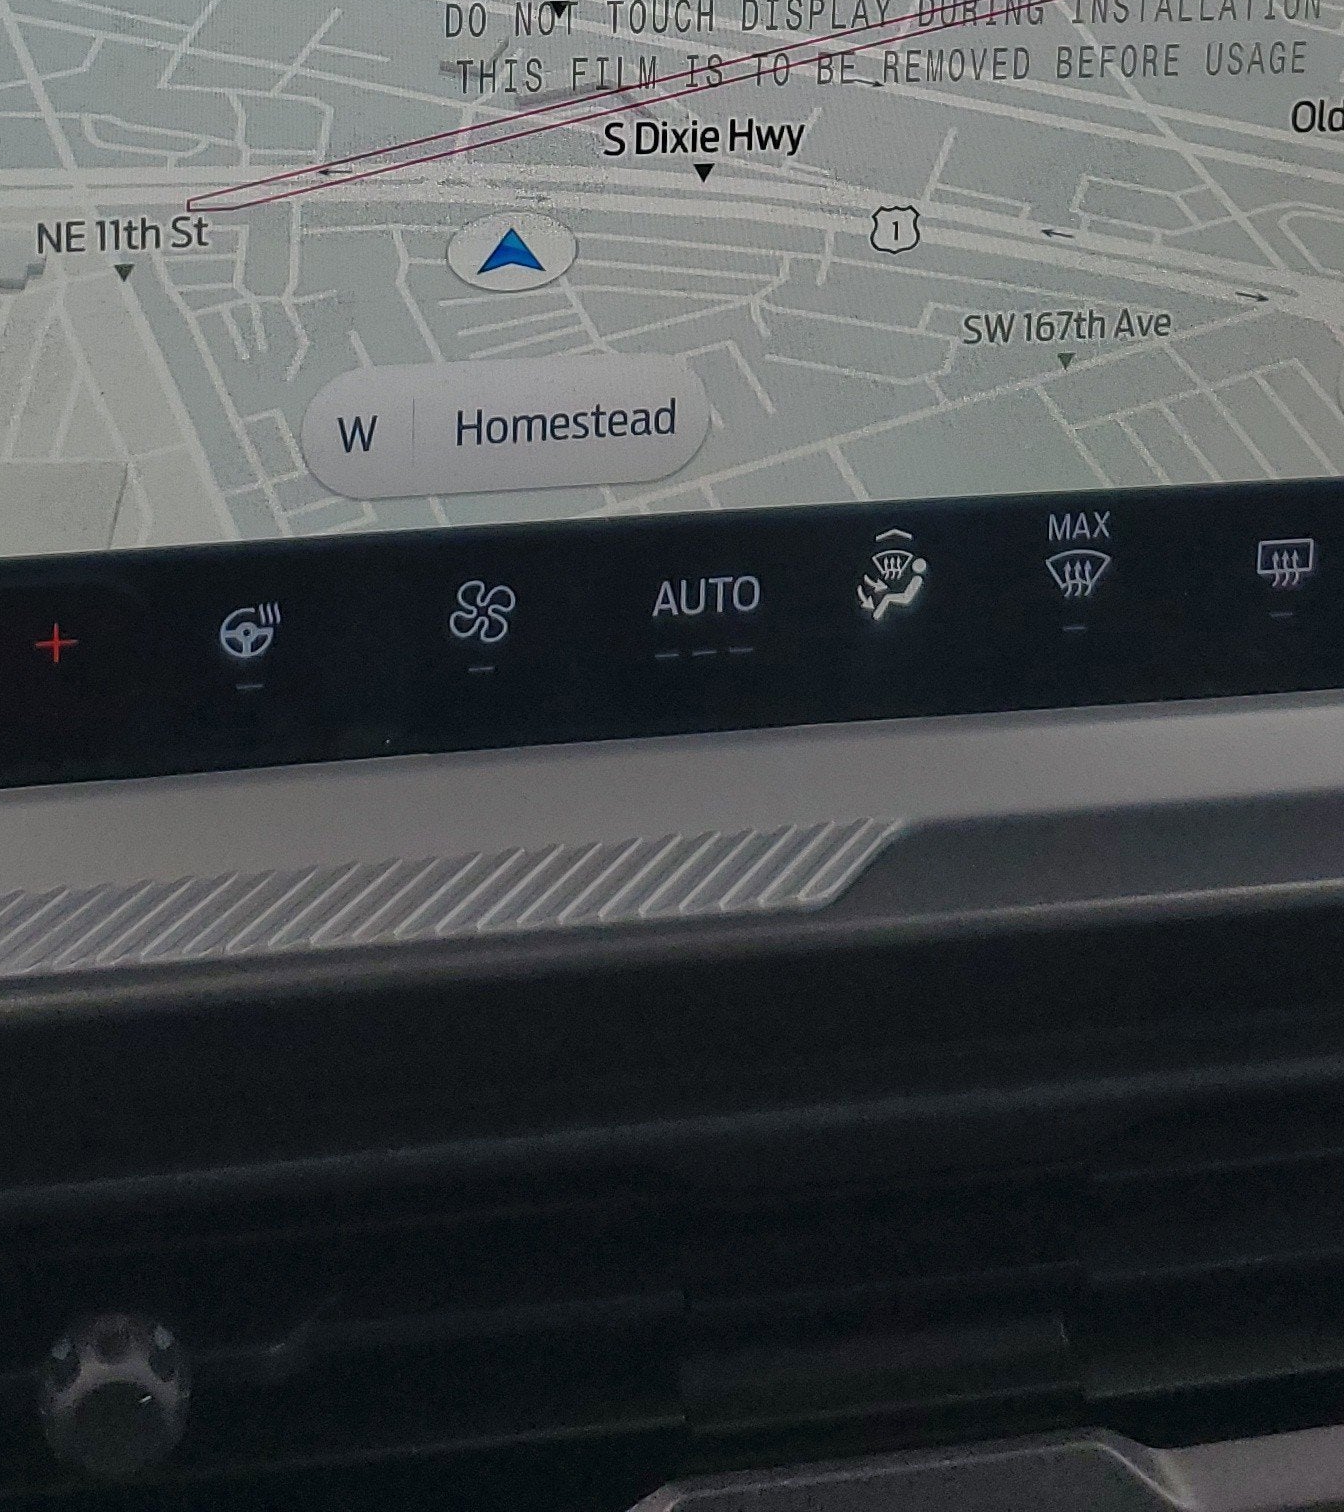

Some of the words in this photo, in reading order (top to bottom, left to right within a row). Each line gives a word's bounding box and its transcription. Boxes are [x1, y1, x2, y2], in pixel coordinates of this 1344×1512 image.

[445, 2, 488, 37] DO
[514, 0, 578, 36] NOT
[458, 58, 544, 95] THIS
[571, 55, 658, 92] FILM
[685, 55, 724, 89] IS
[754, 53, 791, 87] TO
[816, 50, 857, 86] BE
[882, 46, 1032, 84] REMOVED
[1057, 44, 1180, 80] BEFORE
[1204, 41, 1308, 76] USAGE
[603, 123, 627, 157] S
[635, 121, 720, 155] Dixie
[727, 119, 806, 157] Hwy
[36, 221, 85, 253] NE
[95, 218, 161, 251] 11th
[171, 216, 210, 248] St
[891, 220, 900, 241] 1
[963, 312, 1016, 345] SW
[1023, 311, 1106, 343] 167th
[1115, 310, 1172, 338] Ave
[338, 416, 377, 453] W
[457, 398, 676, 446] Homestead
[1049, 510, 1110, 540] MAX
[654, 576, 762, 617] AUTO
